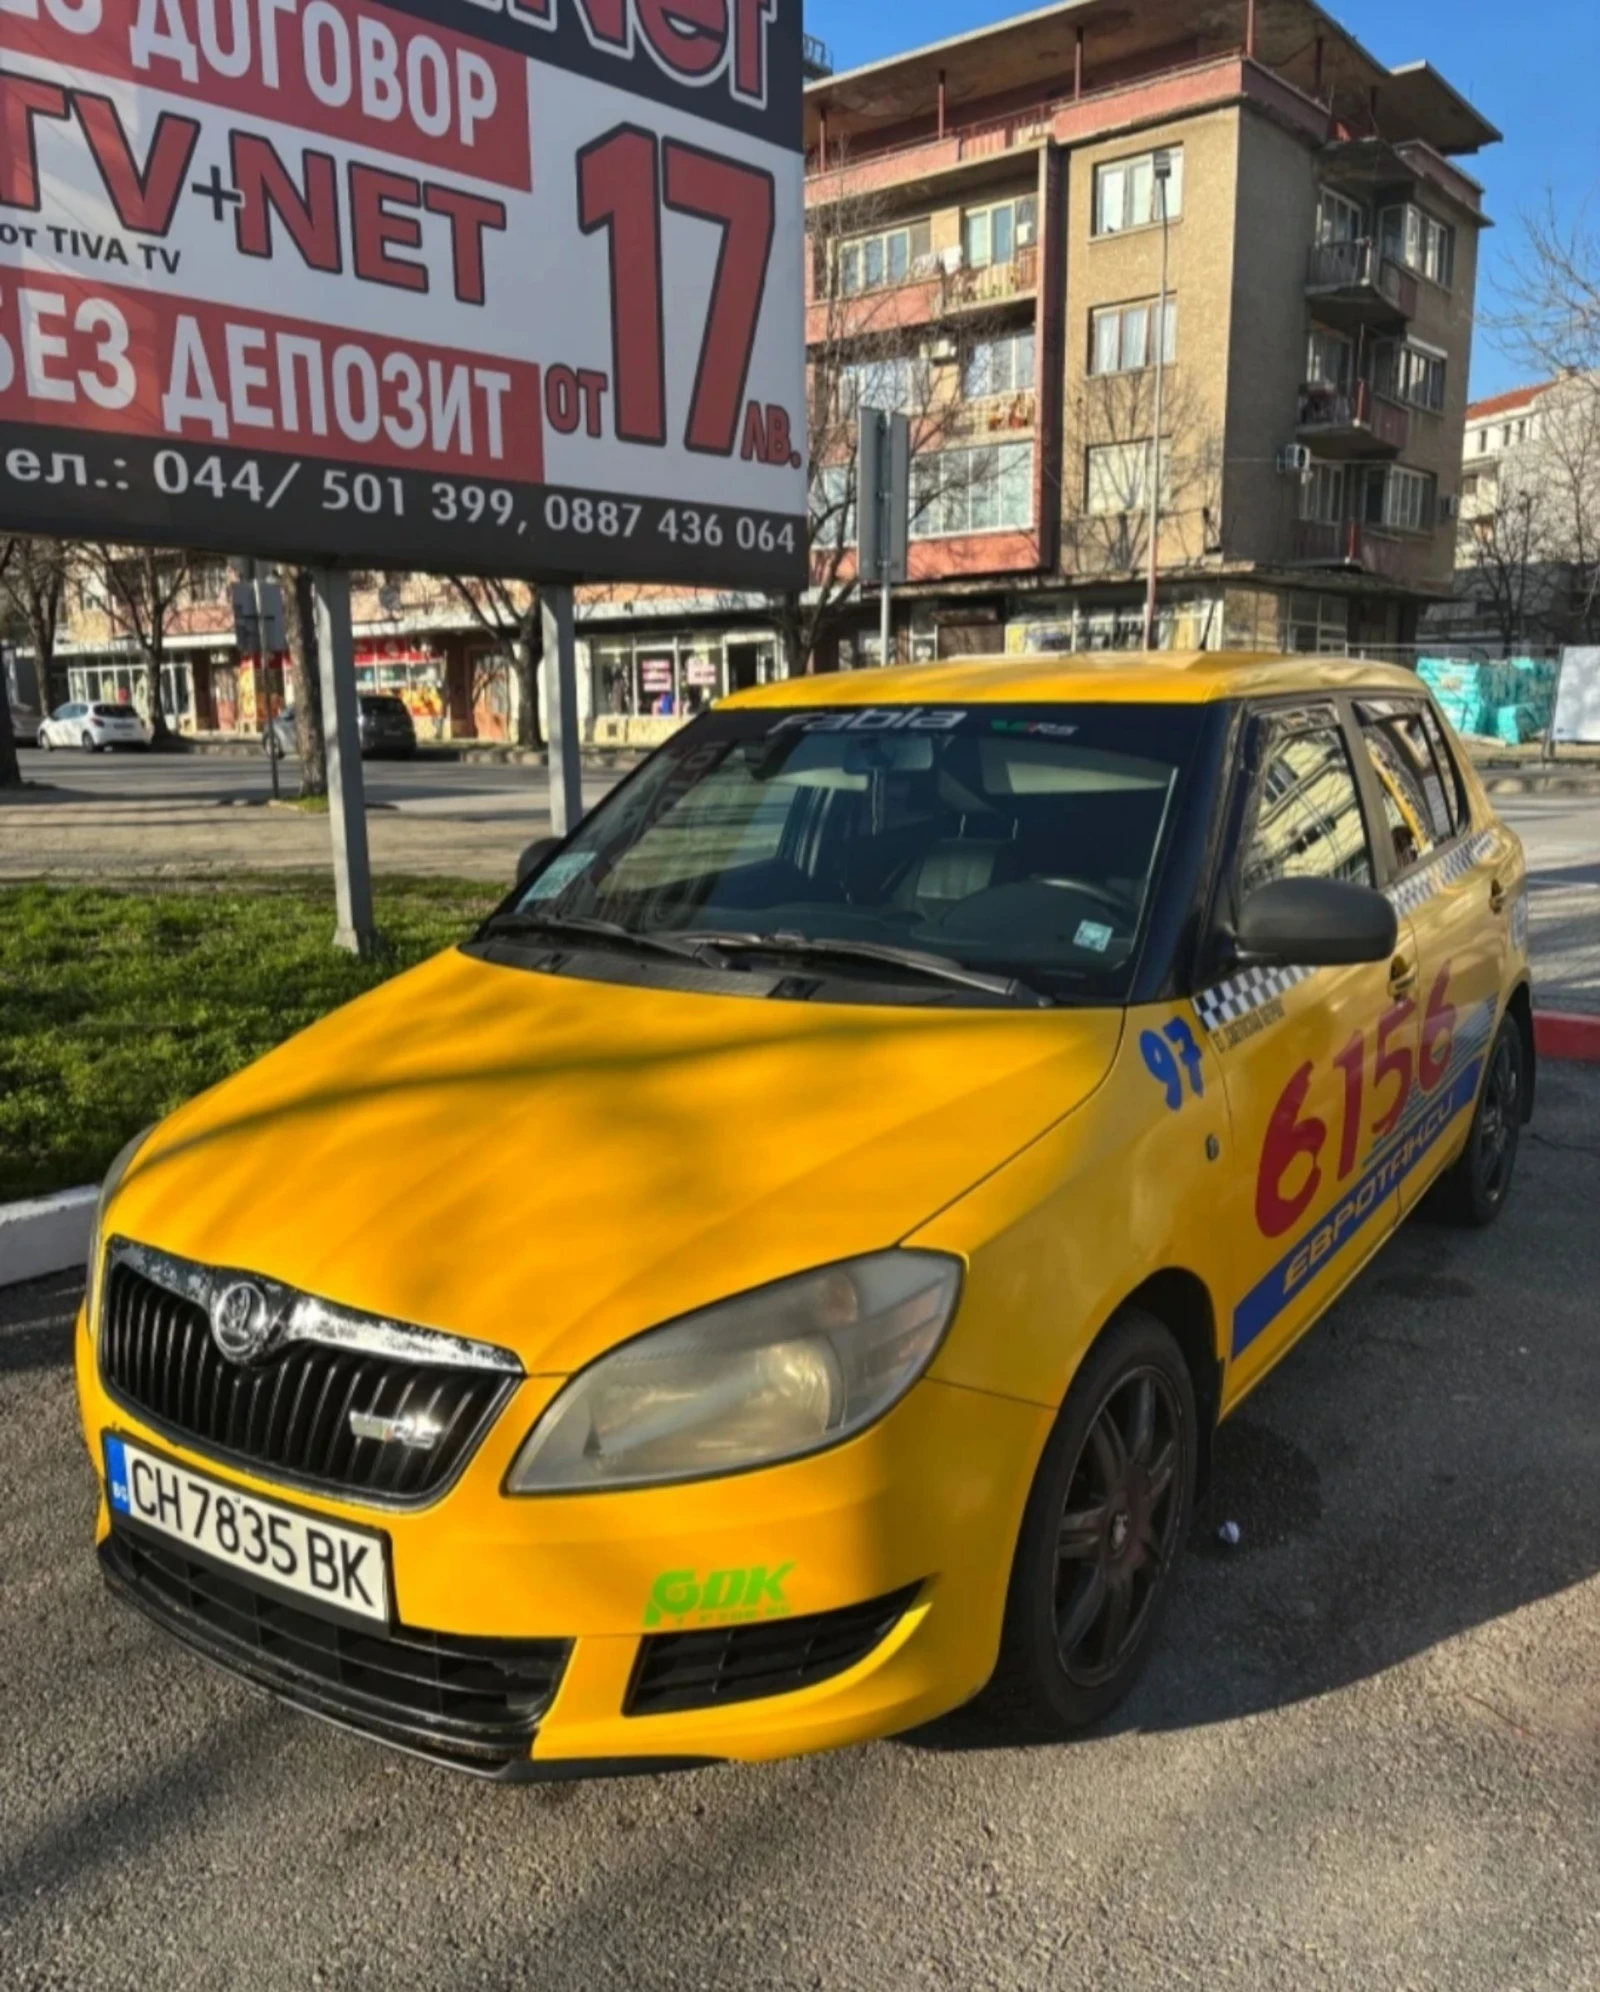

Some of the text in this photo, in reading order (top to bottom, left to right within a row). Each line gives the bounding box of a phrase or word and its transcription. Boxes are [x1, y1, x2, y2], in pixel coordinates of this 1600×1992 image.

[128, 0, 497, 147] ДОГОВОР
[137, 242, 181, 275] TV
[575, 121, 776, 458] 17
[161, 313, 512, 460] ДЕПОЗИТ
[152, 449, 302, 509] 044/
[322, 468, 405, 516] 501
[431, 481, 529, 536] 399,
[544, 494, 643, 538] 0887
[657, 508, 724, 547] 436
[735, 516, 797, 555] 064
[1138, 1014, 1205, 1112] 97
[1254, 958, 1458, 1239] 6156
